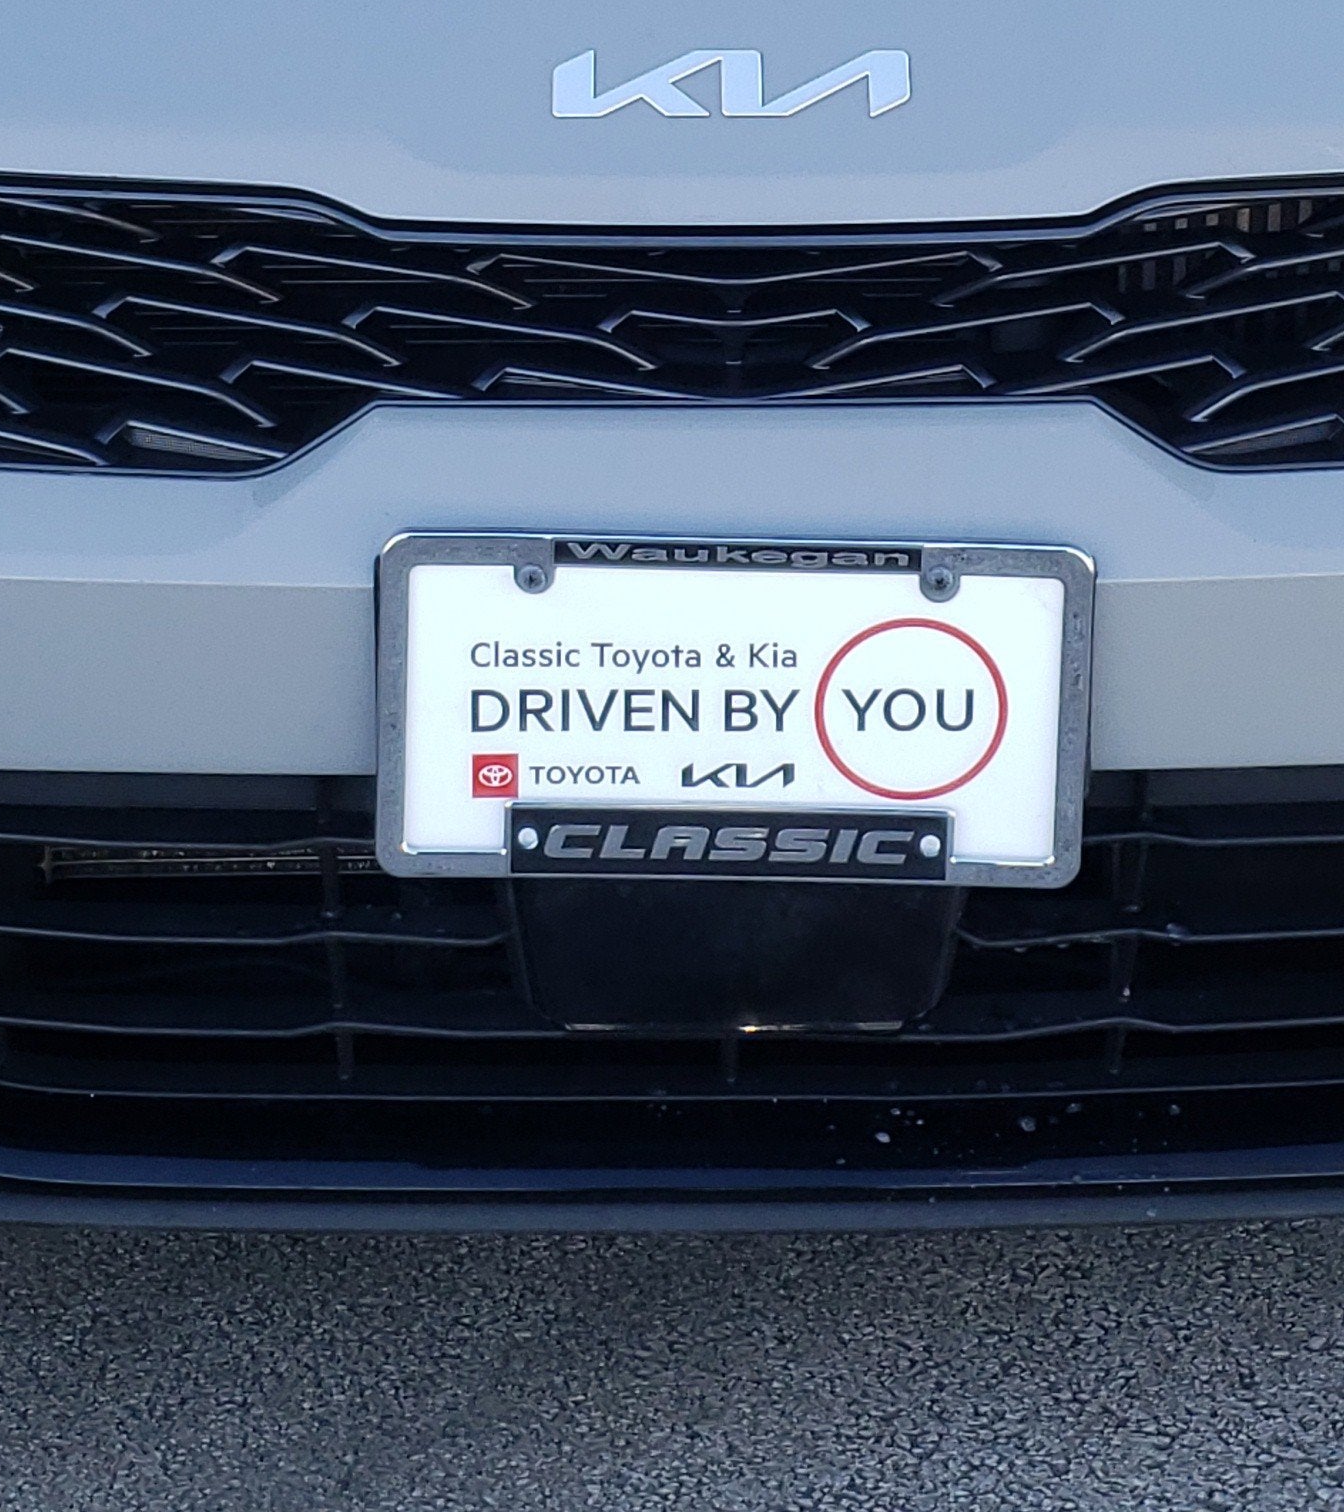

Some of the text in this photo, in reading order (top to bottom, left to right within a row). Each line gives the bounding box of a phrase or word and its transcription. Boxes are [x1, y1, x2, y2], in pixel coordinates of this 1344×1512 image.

[566, 542, 910, 569] Waukegan
[470, 641, 798, 674] Classic Toyota & Kia
[470, 688, 976, 733] DRIVEN BY YOU
[529, 766, 641, 785] TOYOTA
[543, 824, 915, 864] CLASSIC
